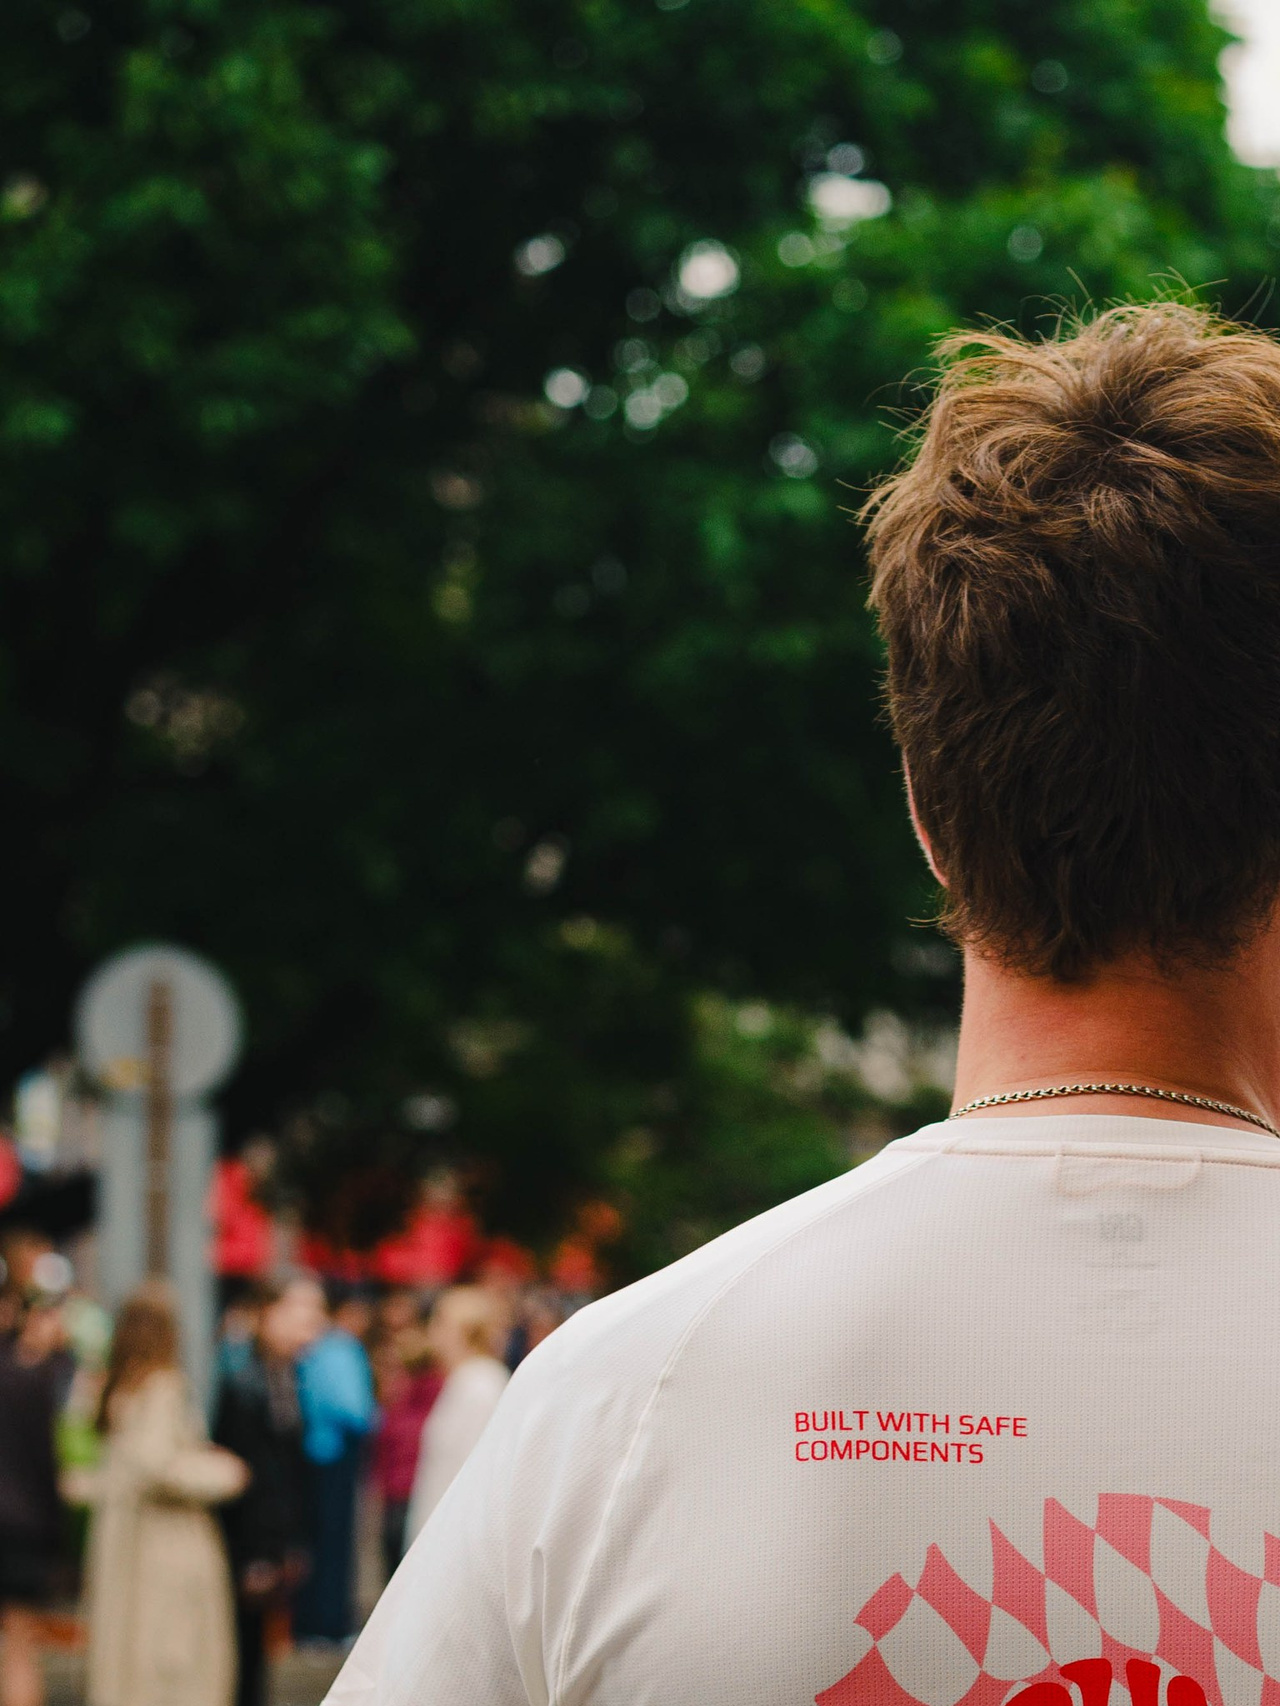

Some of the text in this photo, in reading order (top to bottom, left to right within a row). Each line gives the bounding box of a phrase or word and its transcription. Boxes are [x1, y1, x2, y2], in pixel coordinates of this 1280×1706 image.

[794, 1410, 1028, 1438] BUILT WITH SAFE
[795, 1439, 984, 1464] COMPONENTS
